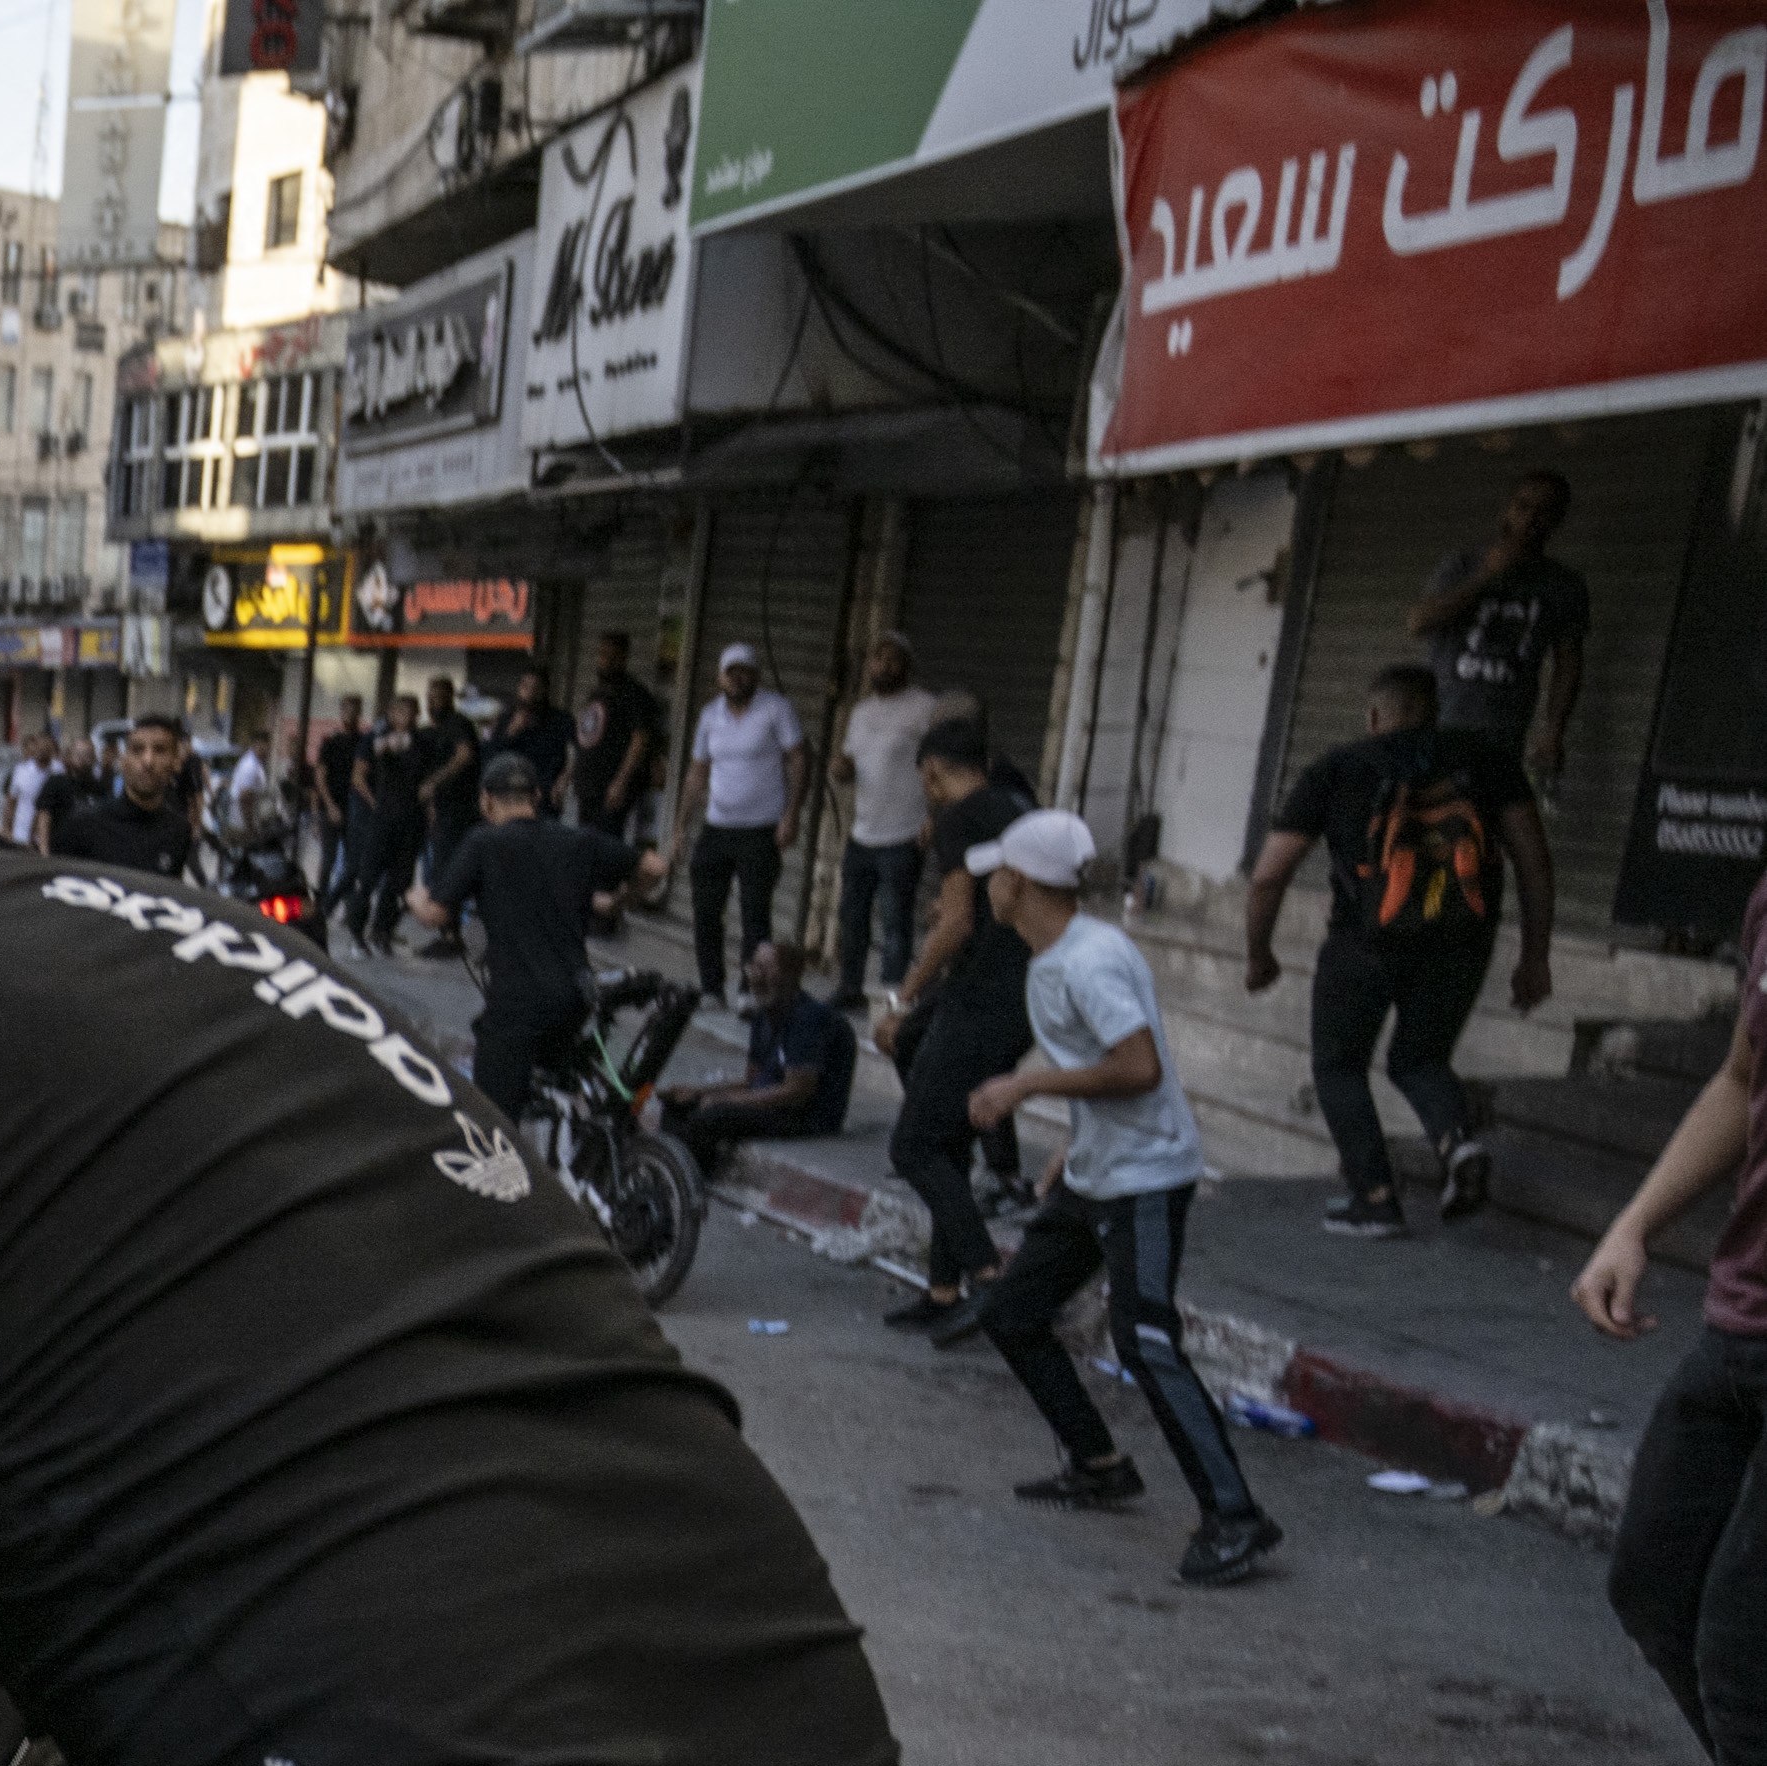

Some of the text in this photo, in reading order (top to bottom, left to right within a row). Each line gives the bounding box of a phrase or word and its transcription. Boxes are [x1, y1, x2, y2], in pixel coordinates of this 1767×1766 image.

[1141, 0, 1767, 358] ماركت سعيد
[40, 875, 454, 1108] adidas
